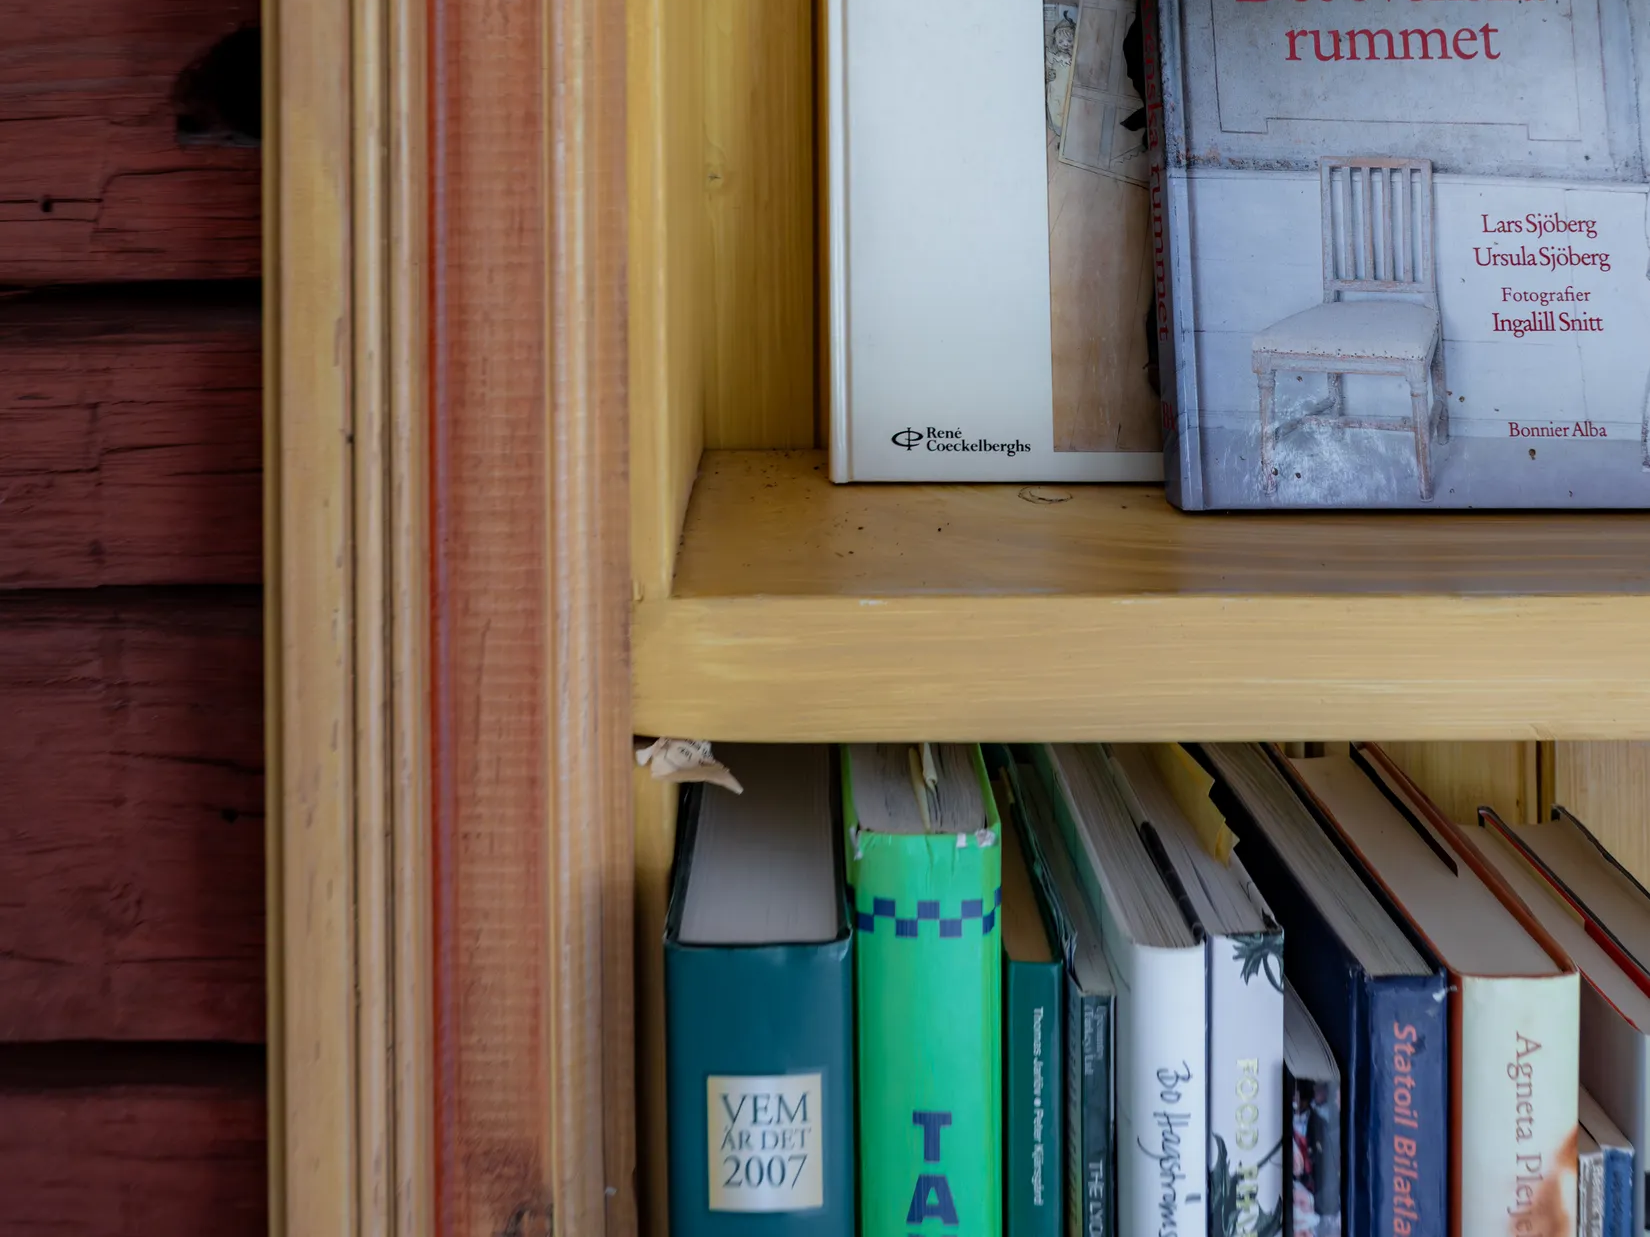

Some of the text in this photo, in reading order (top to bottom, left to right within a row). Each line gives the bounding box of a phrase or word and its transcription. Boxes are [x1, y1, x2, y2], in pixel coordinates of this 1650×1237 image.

[1285, 22, 1500, 62] rummet
[1481, 212, 1598, 239] Lars Sjöberg
[1150, 163, 1169, 341] rummet
[1472, 245, 1612, 272] Ursula Sjöberg
[1501, 285, 1591, 307] Fotografier
[1492, 311, 1604, 338] Ingalill Snitt
[926, 427, 1031, 457] René Coeckelberghs
[1508, 421, 1607, 438] Bonnier Alba
[1393, 1022, 1419, 1129] Statoil
[1507, 1031, 1543, 1143] Agneta
[720, 1090, 812, 1126] VEM
[1235, 1058, 1259, 1151] FOOD
[760, 1128, 812, 1151] DET
[1033, 1108, 1044, 1142] Peter
[722, 1153, 808, 1190] 2007
[906, 1109, 960, 1237] TA
[1088, 1159, 1104, 1199] THE
